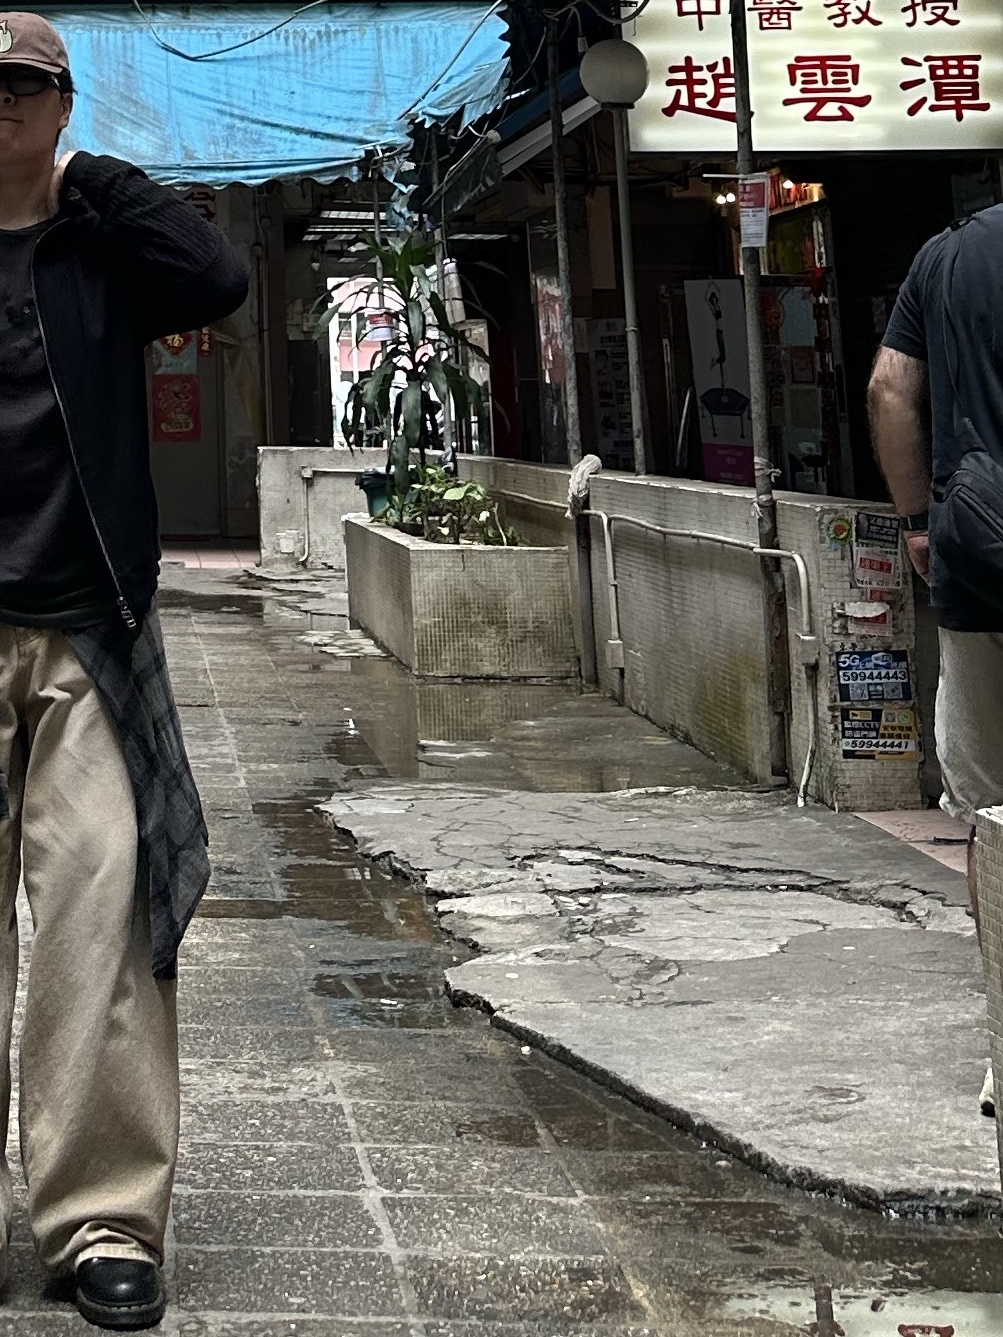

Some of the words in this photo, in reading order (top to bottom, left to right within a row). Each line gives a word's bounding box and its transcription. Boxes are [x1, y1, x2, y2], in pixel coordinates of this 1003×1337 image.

[661, 54, 991, 123] 趙雲潭
[838, 653, 860, 668] 5G
[842, 671, 907, 682] 59944443
[851, 740, 909, 749] 59944441
